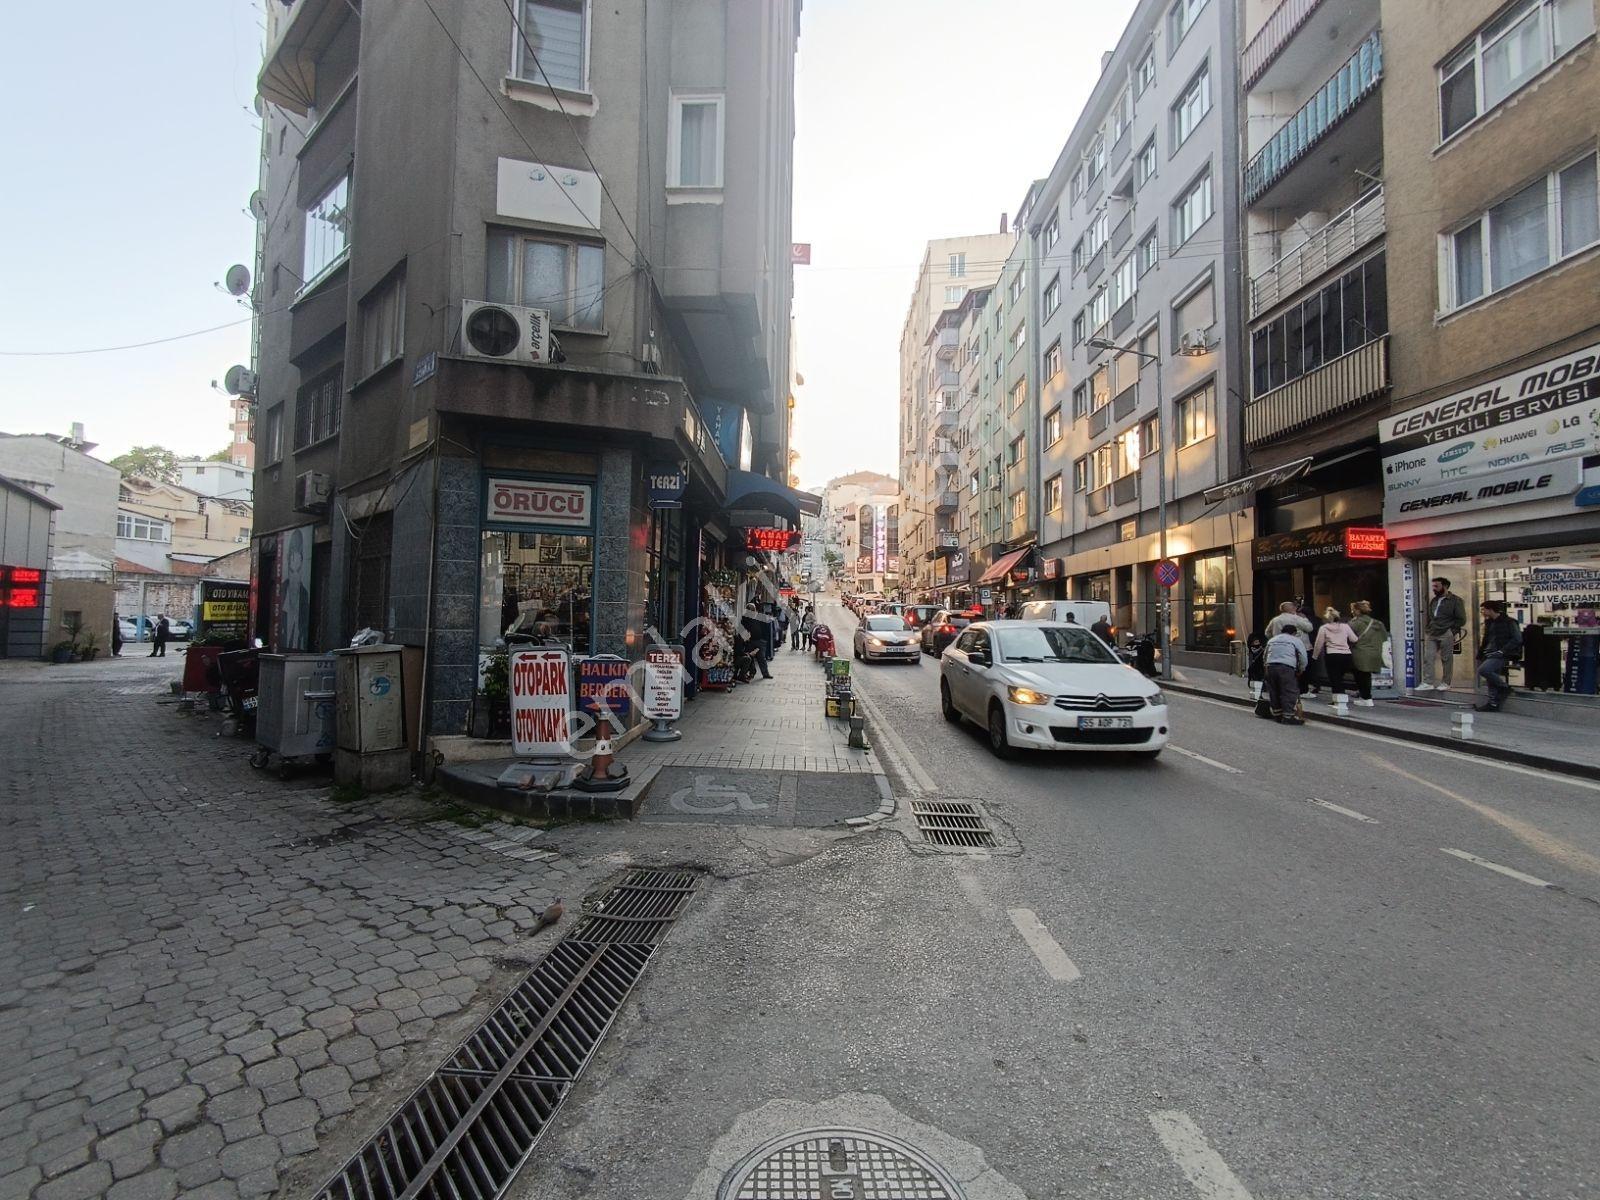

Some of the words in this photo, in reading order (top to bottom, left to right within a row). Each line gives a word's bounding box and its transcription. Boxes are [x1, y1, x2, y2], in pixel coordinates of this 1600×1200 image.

[530, 312, 543, 350] arçelik
[1392, 386, 1510, 437] GENERAL
[1423, 411, 1490, 444] YETKİLİ
[1499, 381, 1589, 423] SERVİSİ
[1562, 416, 1581, 429] LG
[1499, 429, 1538, 446] HUAWEI
[1544, 438, 1586, 456] ASUS
[1394, 457, 1427, 474] iPhone
[1487, 452, 1530, 469] NOKIA
[650, 472, 680, 490] TERZİ
[1387, 478, 1422, 492] SUNNY
[1399, 490, 1474, 513] GENERAL
[1477, 474, 1553, 500] MOBILE
[1294, 547, 1321, 559] SULTAN
[1547, 595, 1559, 603] VE
[649, 653, 680, 663] TERZİ
[581, 663, 631, 676] HALKIN
[513, 662, 568, 697] OTOPARK
[515, 708, 568, 743] OTOYIKAMA
